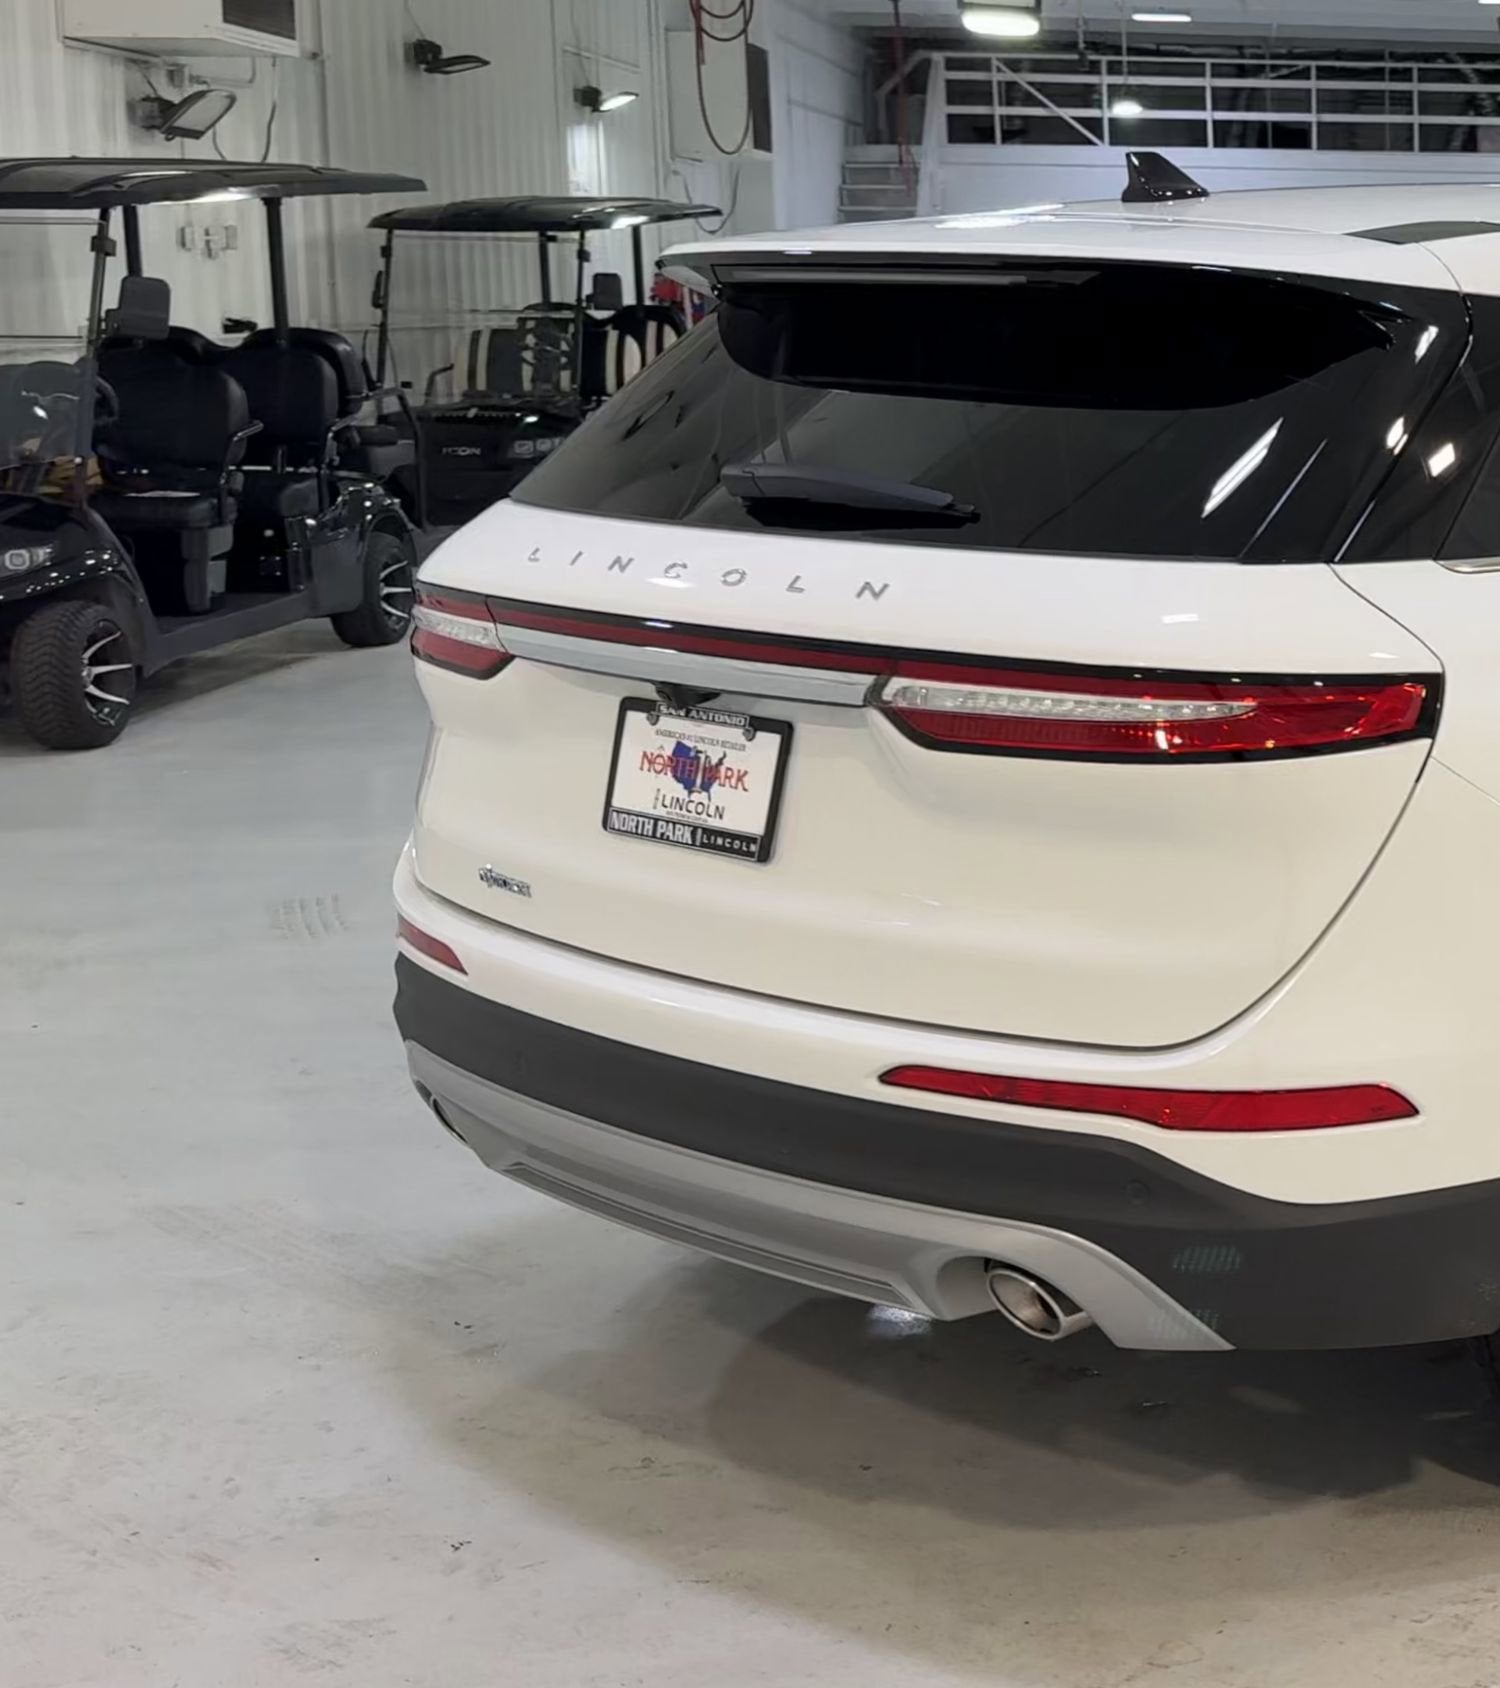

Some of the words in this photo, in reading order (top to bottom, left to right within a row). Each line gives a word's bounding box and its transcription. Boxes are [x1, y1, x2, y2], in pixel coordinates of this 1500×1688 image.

[527, 547, 890, 600] LINCOLN
[660, 704, 687, 717] SAN
[688, 709, 746, 726] ANTONIO
[639, 750, 699, 780] NORTH
[703, 759, 749, 792] PARK
[661, 793, 726, 821] LINCOLN
[610, 811, 654, 836] NORTH
[656, 820, 695, 845] PARK
[702, 833, 757, 852] LINCOLN
